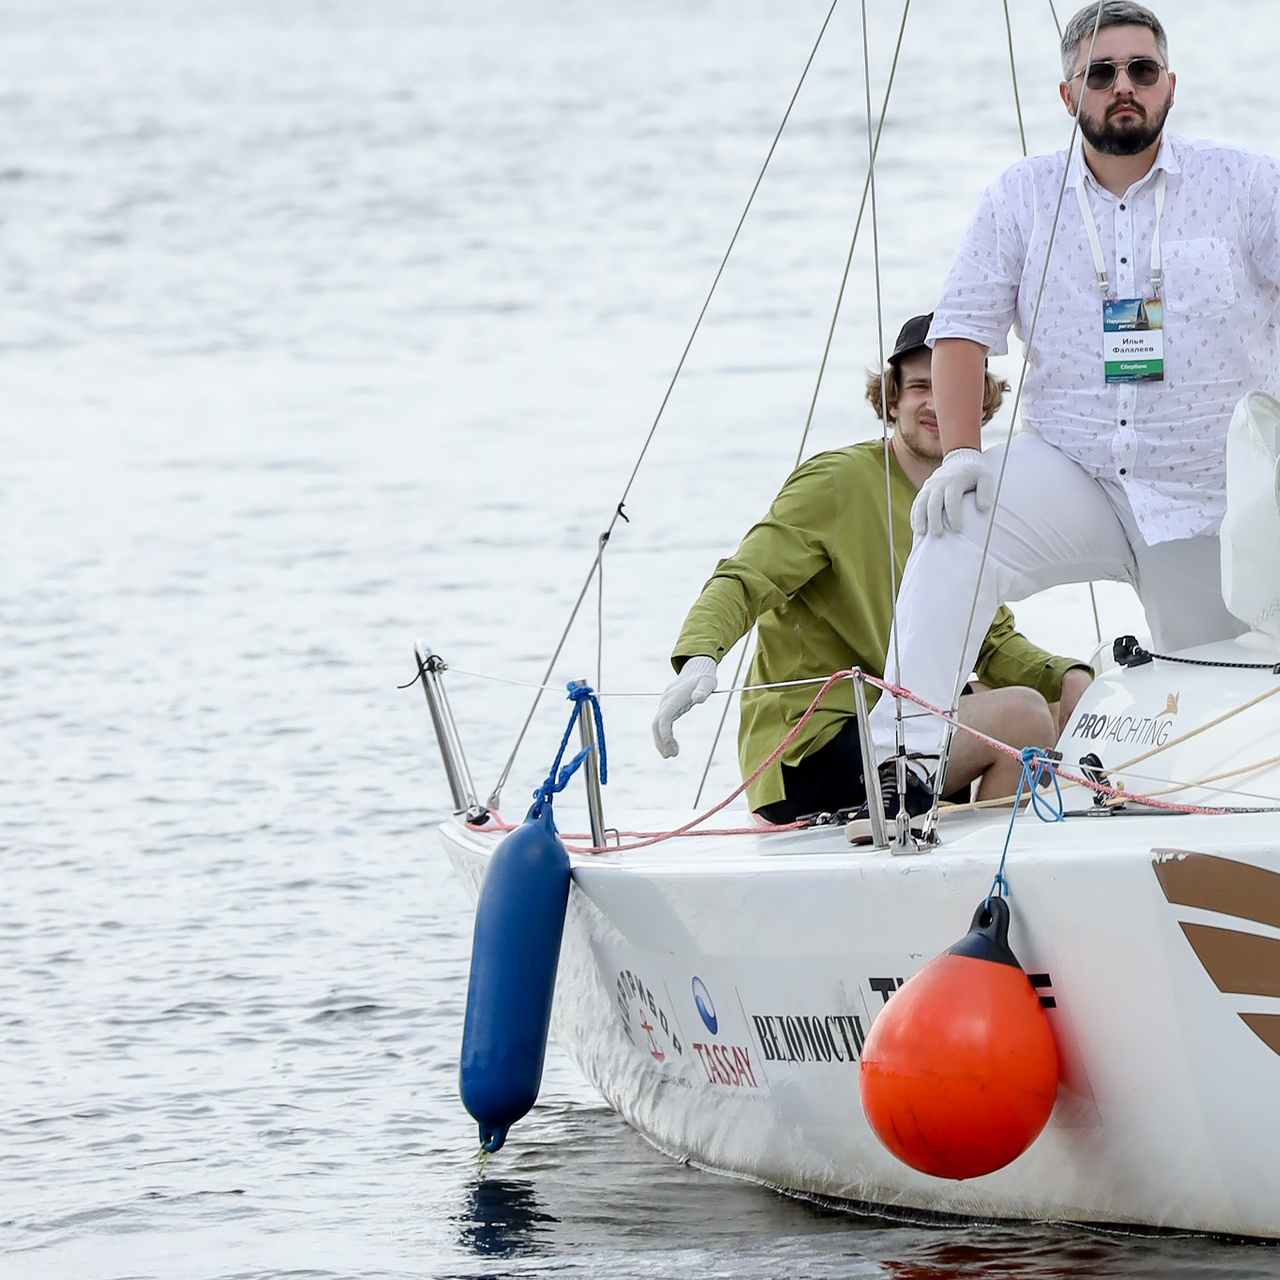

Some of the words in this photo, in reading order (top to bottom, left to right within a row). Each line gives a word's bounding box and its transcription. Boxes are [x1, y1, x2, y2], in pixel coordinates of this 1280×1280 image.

[1071, 713, 1173, 747] PROYACHTING
[752, 1015, 866, 1067] ВЕДОМОСТИ
[693, 1043, 758, 1088] TASSAY
